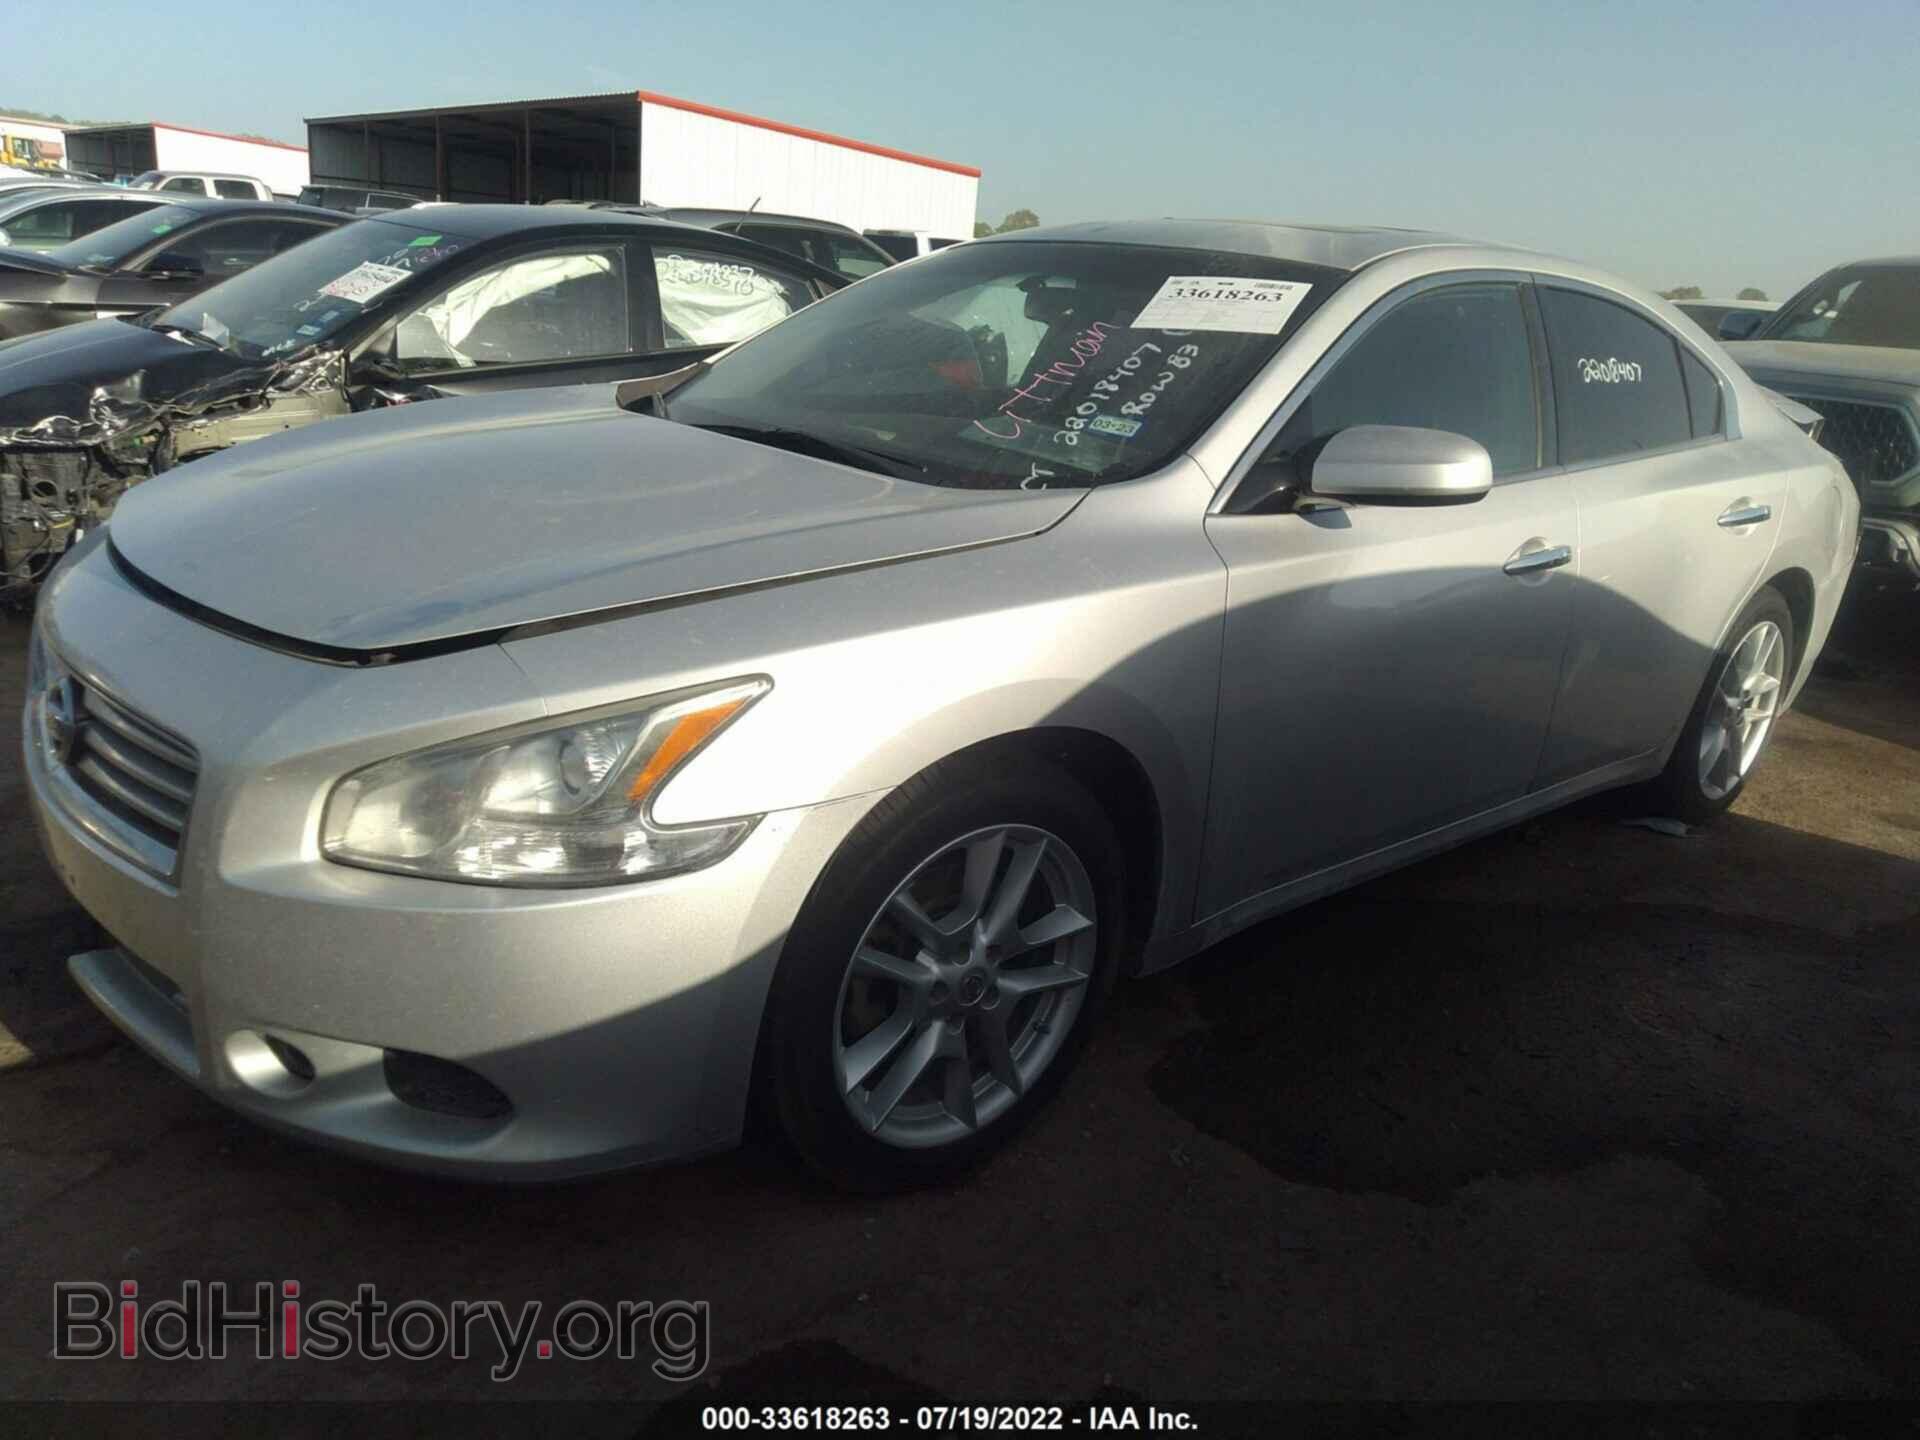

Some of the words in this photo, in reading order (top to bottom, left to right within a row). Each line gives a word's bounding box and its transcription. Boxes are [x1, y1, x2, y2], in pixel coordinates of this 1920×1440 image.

[1167, 288, 1283, 302] 33618263
[1167, 344, 1199, 369] 83
[1053, 342, 1162, 446] 22018407
